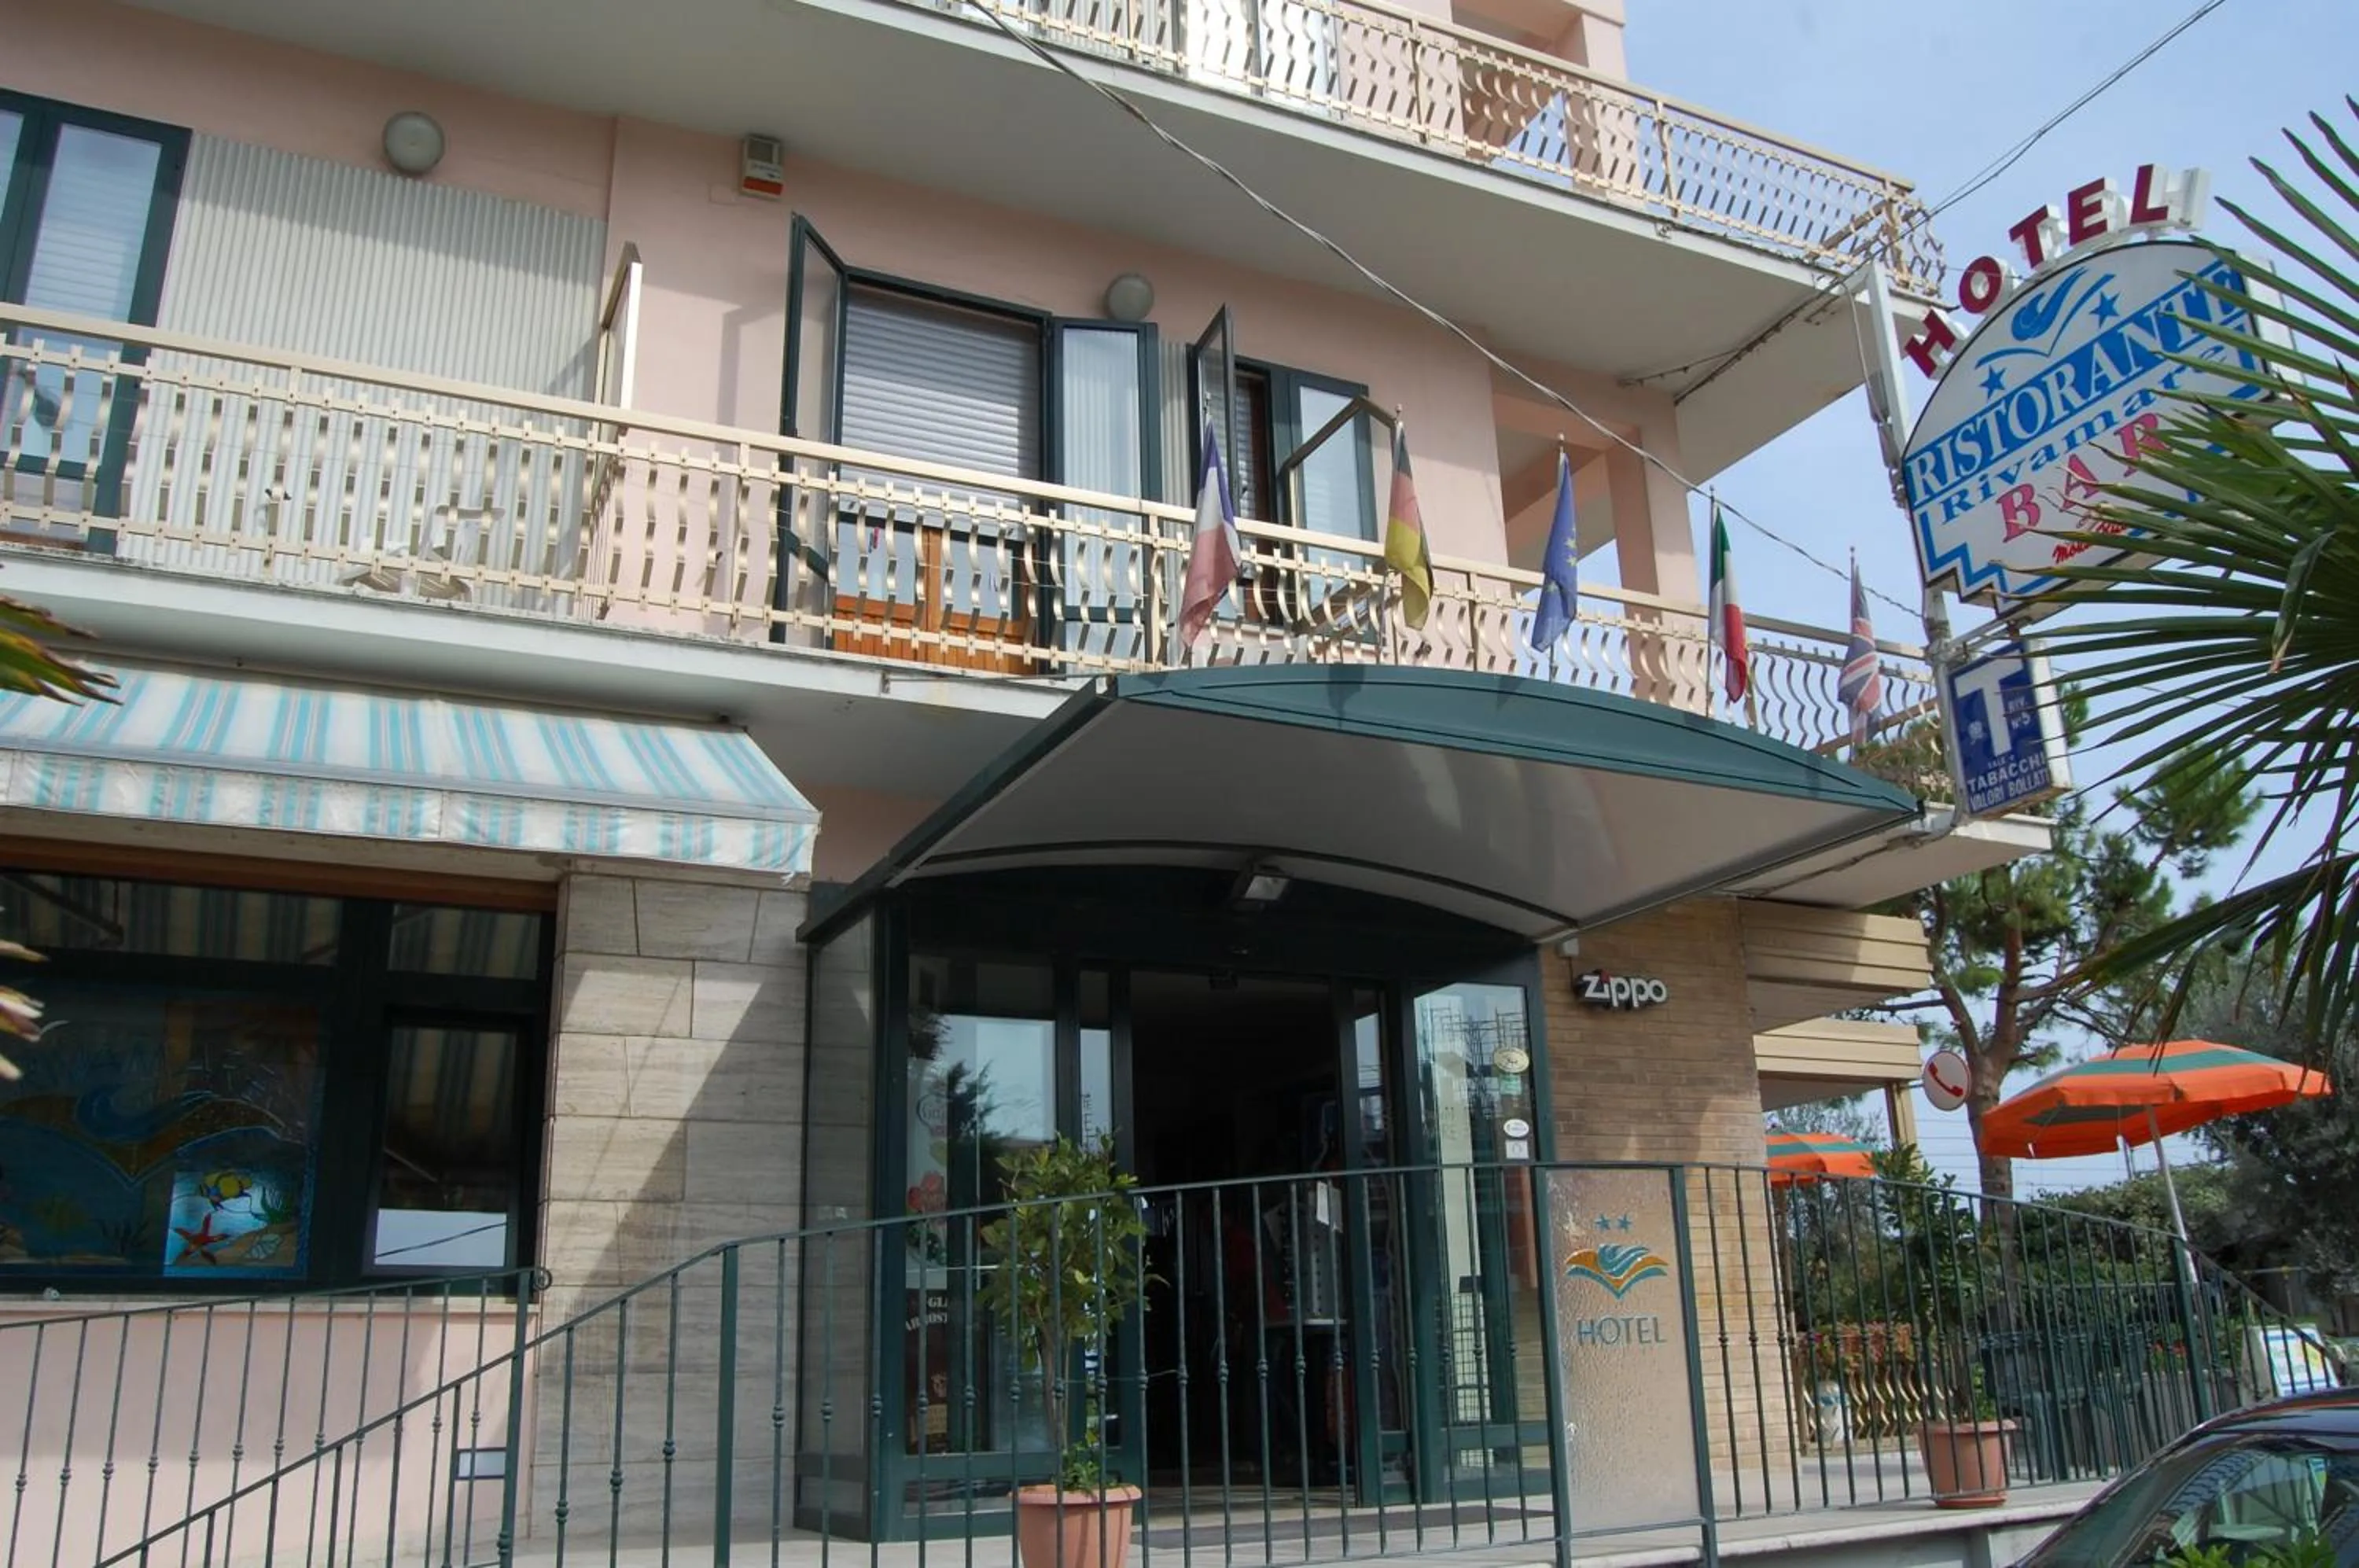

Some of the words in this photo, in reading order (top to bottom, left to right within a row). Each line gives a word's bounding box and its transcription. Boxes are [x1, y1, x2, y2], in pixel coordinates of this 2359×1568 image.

[1904, 164, 2170, 379] HOTEL
[1995, 412, 2172, 543] BAR
[1967, 751, 2046, 793] TABACCHI
[1969, 784, 2005, 812] VALORI
[1581, 969, 1668, 1008] Zippo
[1577, 1315, 1669, 1347] HOTEL
